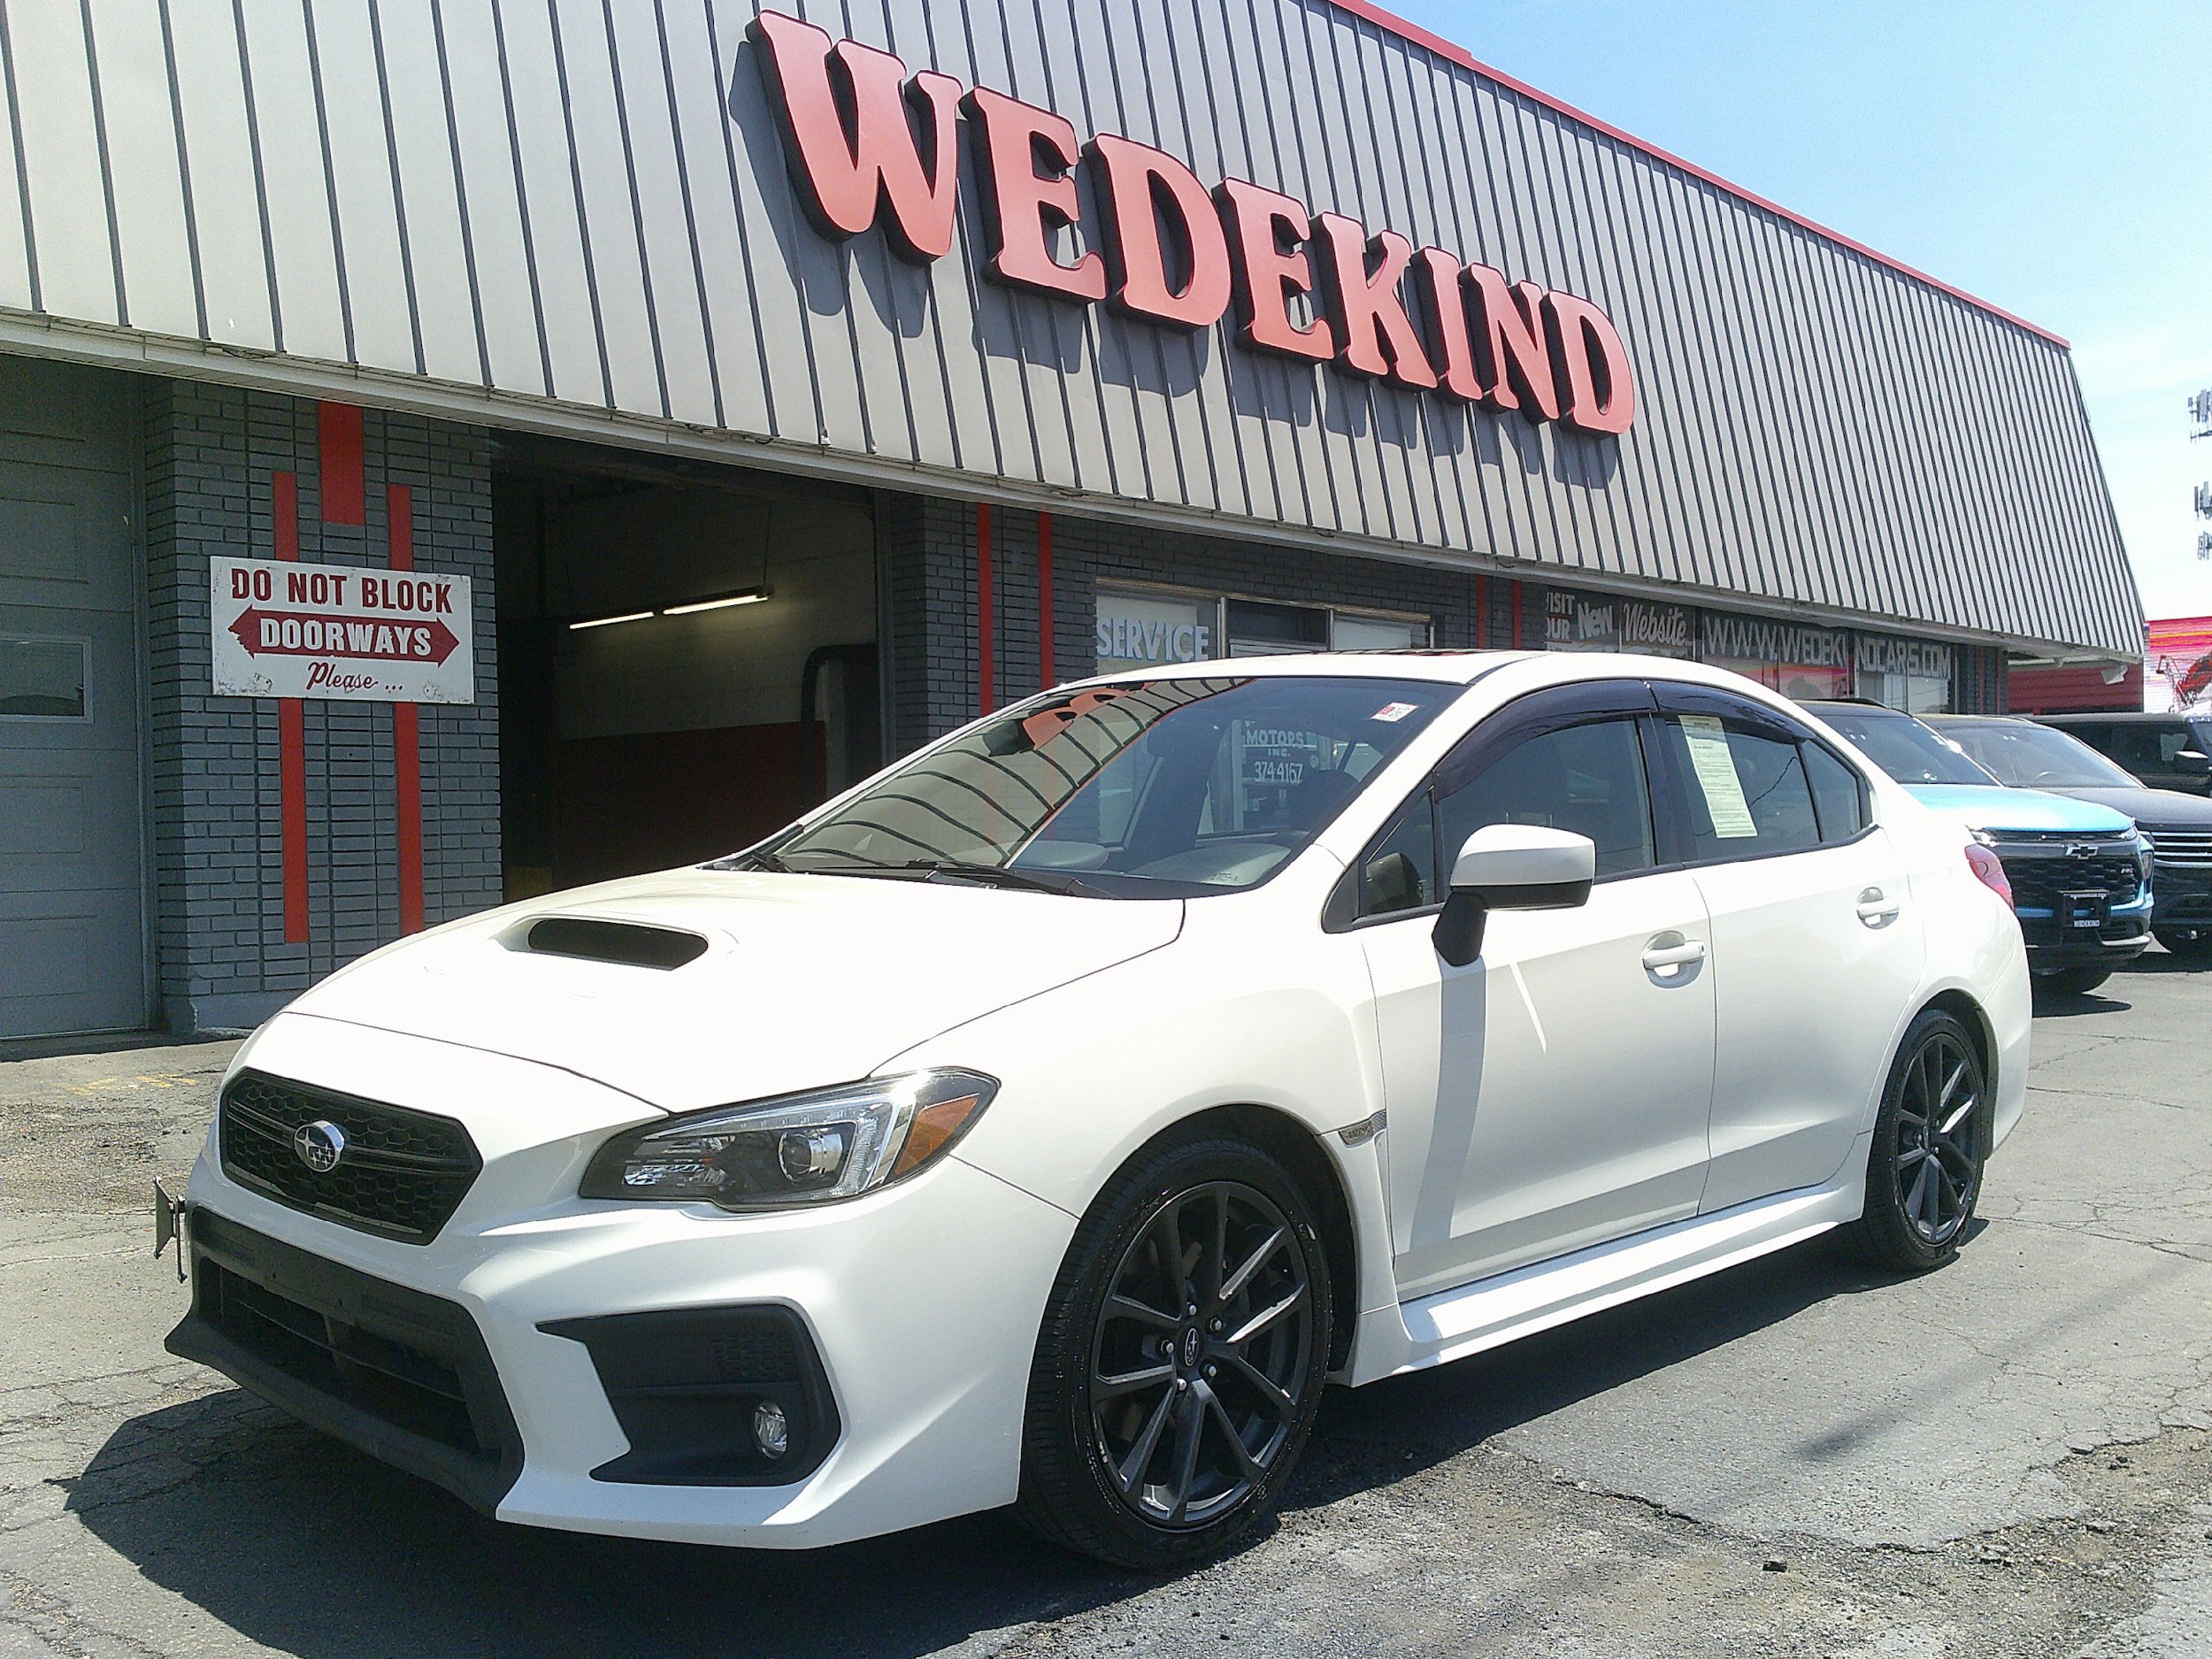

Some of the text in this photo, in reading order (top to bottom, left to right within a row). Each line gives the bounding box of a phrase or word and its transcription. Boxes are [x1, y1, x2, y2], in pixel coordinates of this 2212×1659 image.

[749, 10, 1634, 435] WEDEKIND
[231, 568, 453, 614] DO NOT BLOCK
[259, 618, 432, 657] DOORWAYS
[1096, 618, 1210, 662] SERVICE
[306, 662, 378, 690] Please
[1246, 729, 1304, 749] MOTORS
